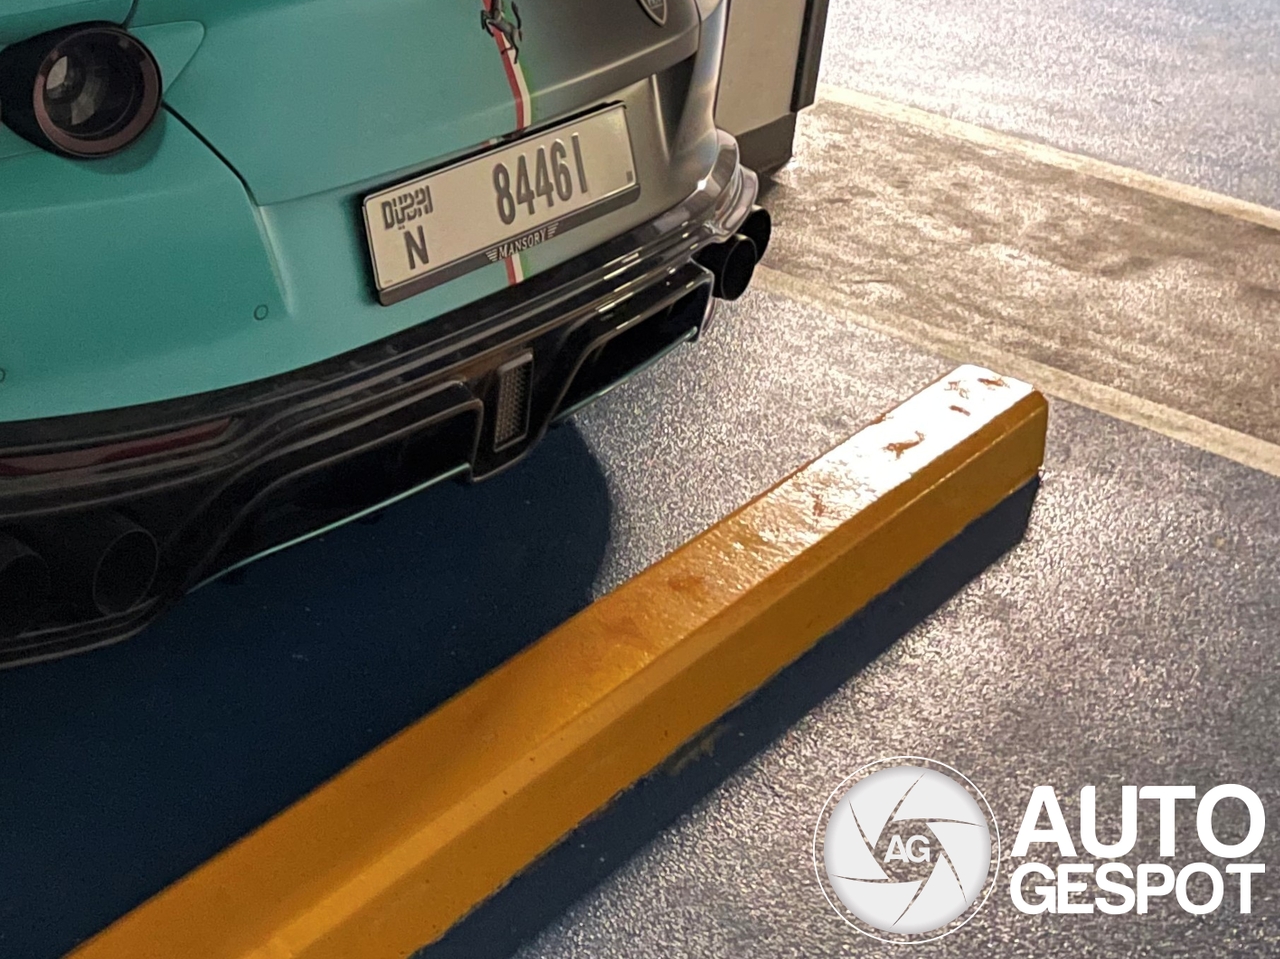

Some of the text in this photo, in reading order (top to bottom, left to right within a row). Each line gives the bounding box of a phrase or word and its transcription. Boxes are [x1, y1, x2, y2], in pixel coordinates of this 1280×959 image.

[492, 132, 588, 226] 84461
[403, 225, 430, 270] N
[497, 228, 548, 260] MANSORY
